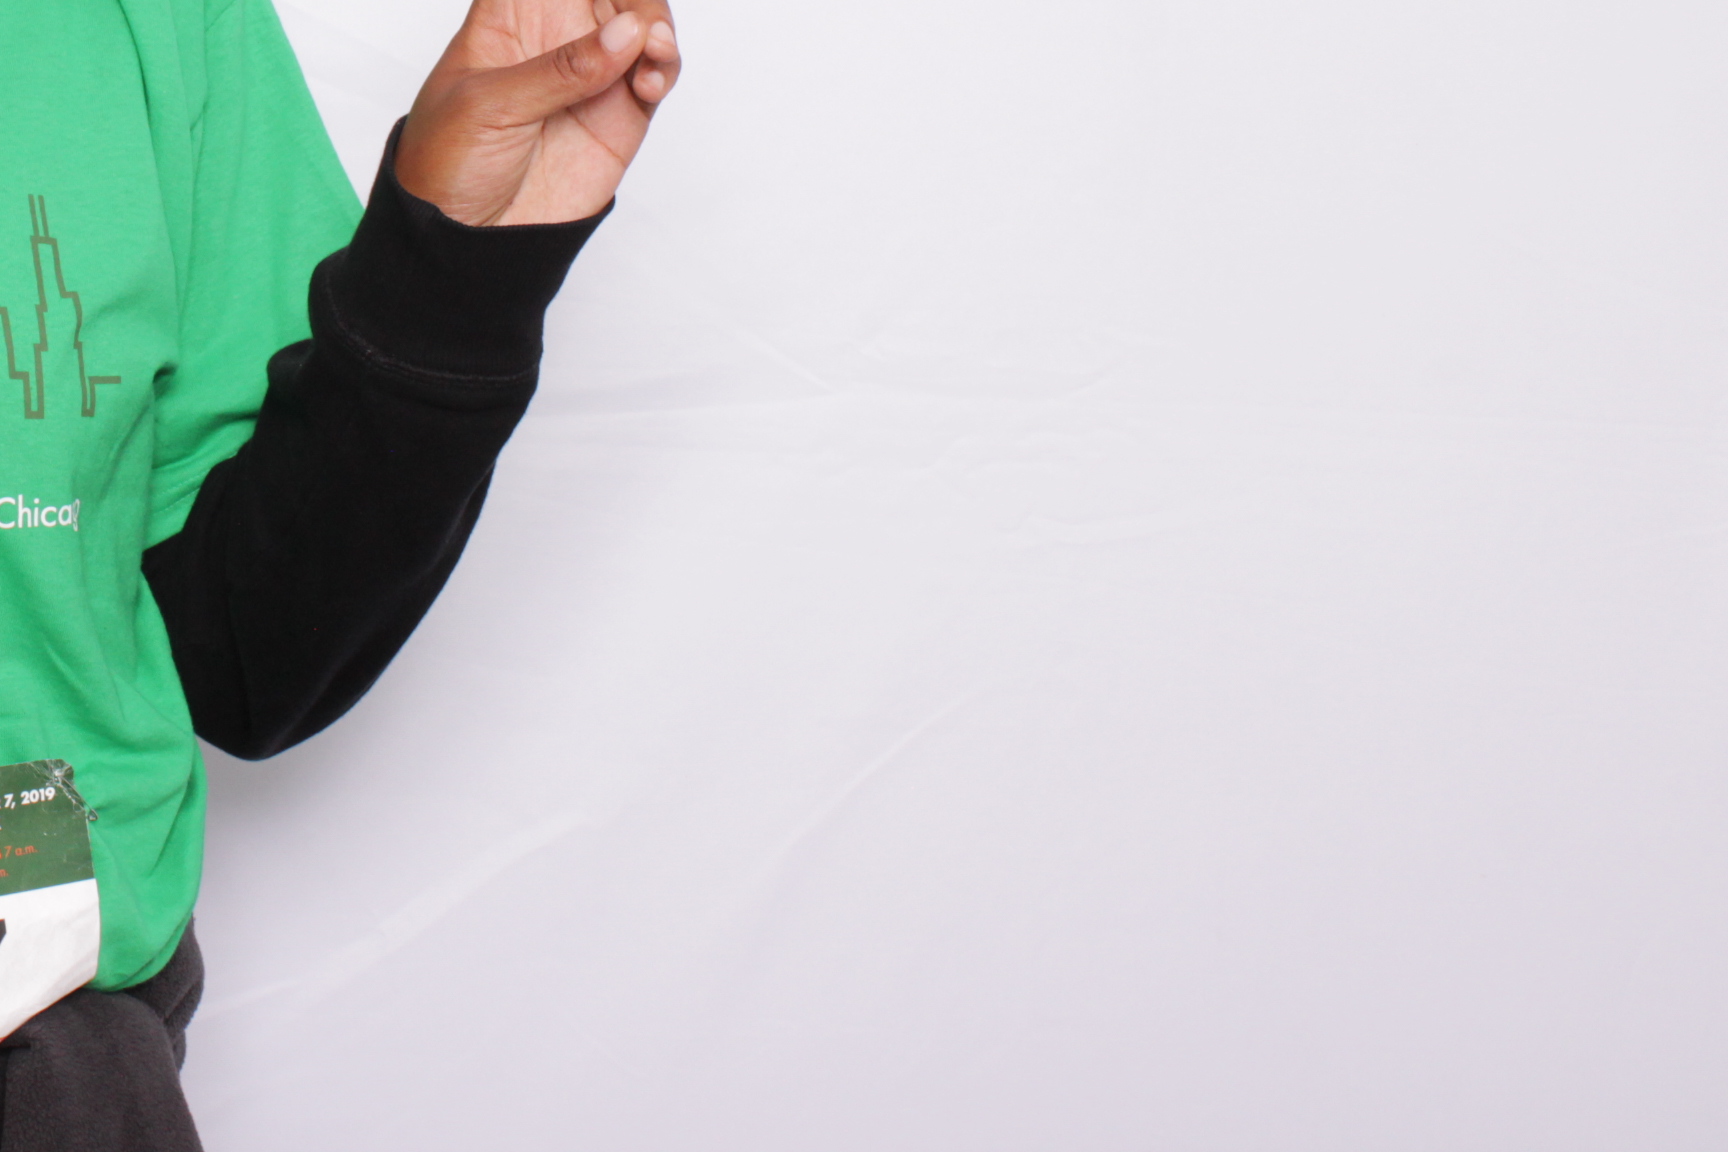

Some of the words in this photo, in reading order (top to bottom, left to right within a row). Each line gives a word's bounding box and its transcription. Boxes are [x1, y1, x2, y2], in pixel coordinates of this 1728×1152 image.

[4, 793, 16, 810] 7,
[20, 786, 56, 806] 2019
[4, 845, 13, 858] 7
[15, 843, 38, 856] a.m.
